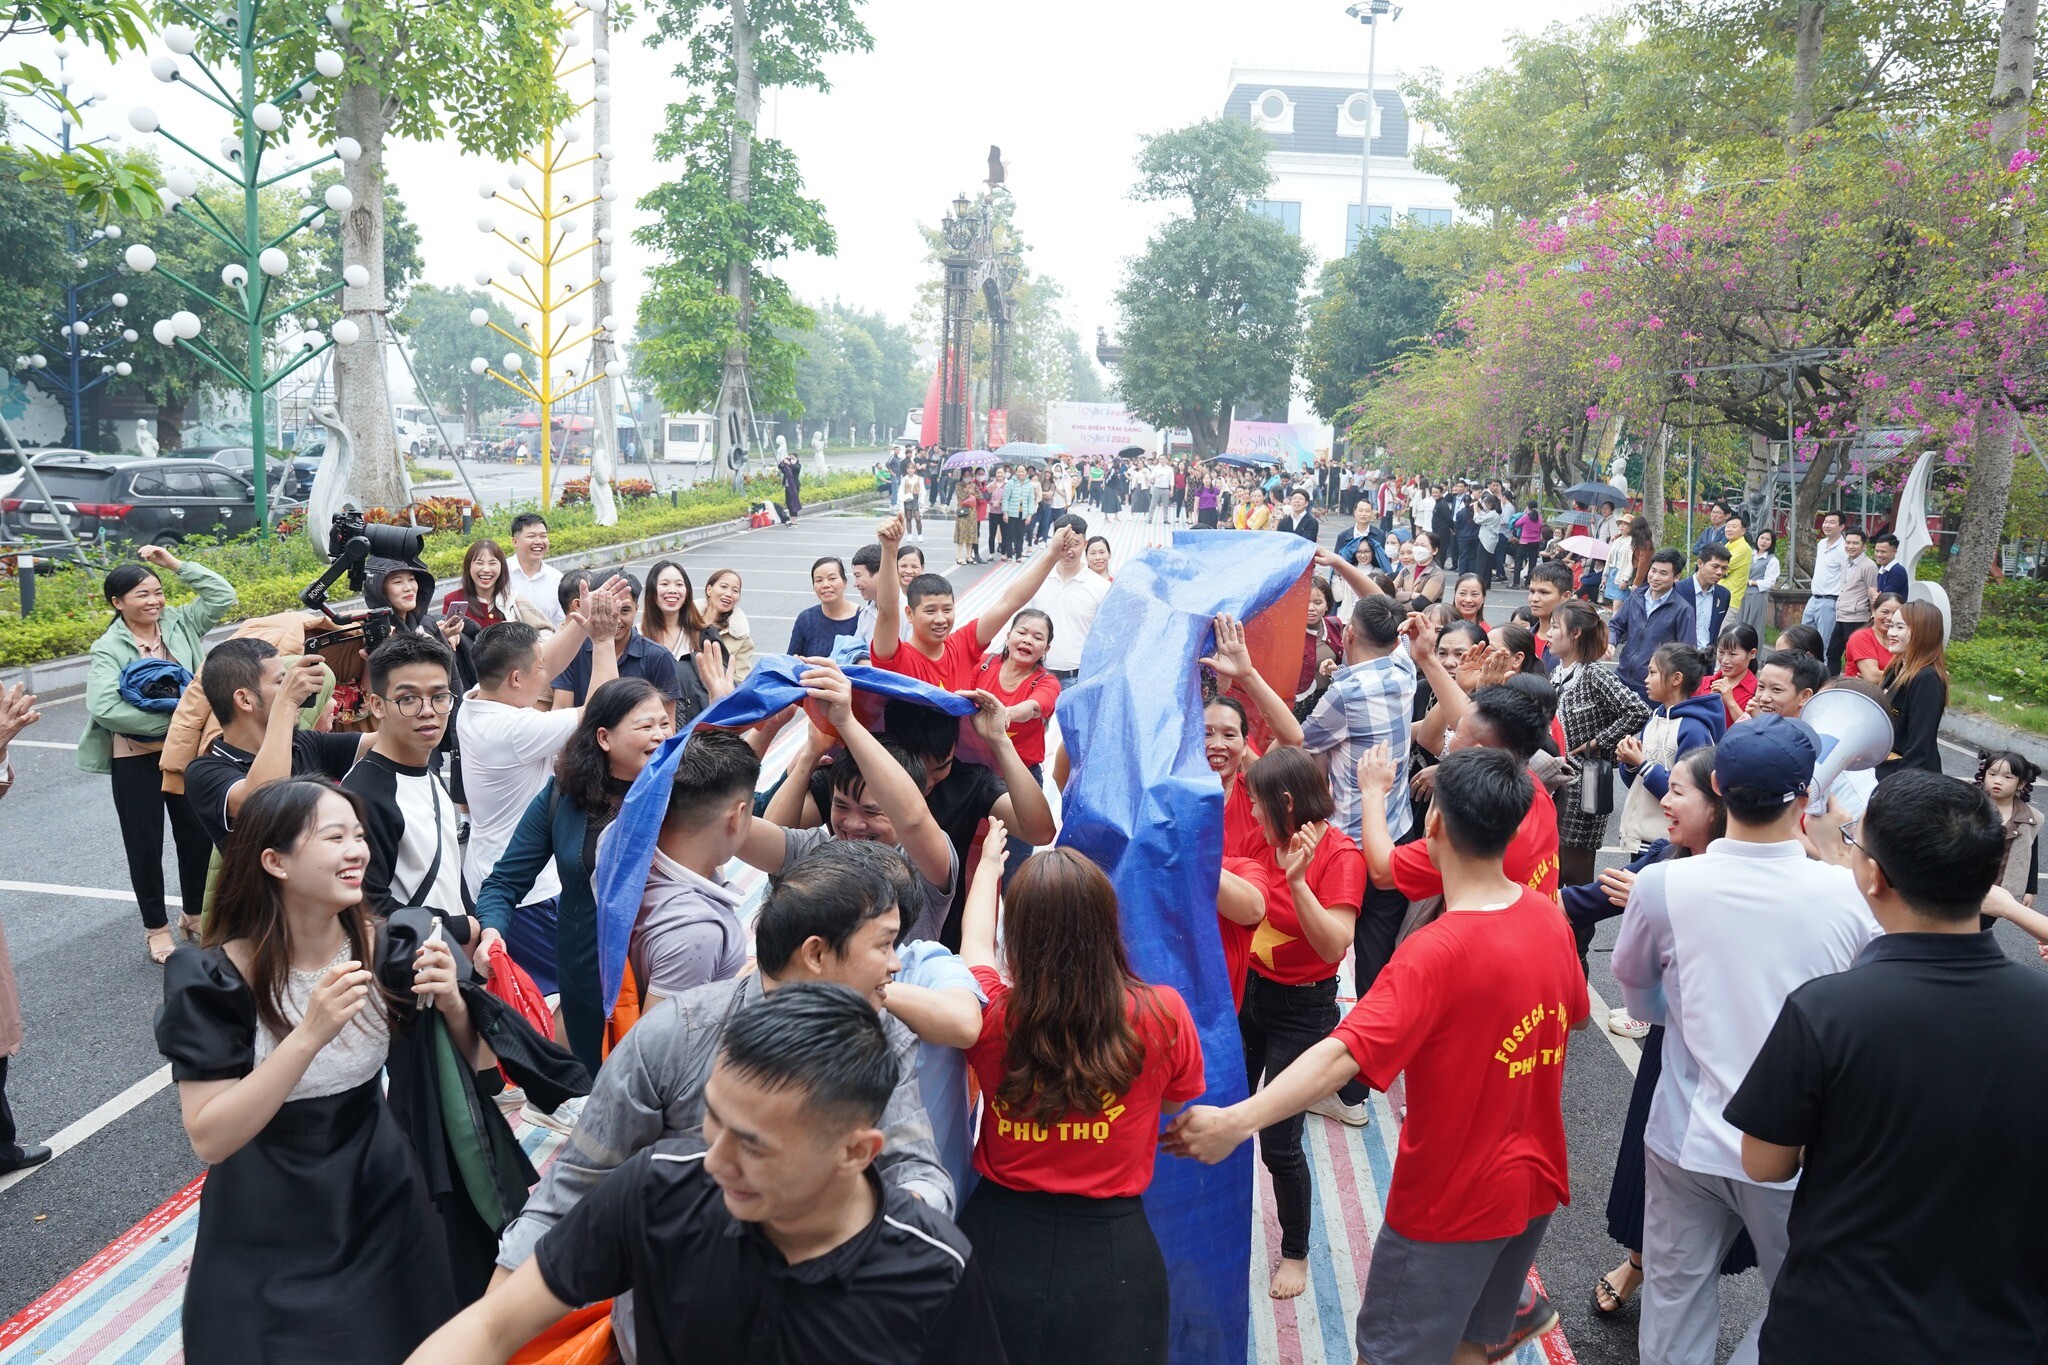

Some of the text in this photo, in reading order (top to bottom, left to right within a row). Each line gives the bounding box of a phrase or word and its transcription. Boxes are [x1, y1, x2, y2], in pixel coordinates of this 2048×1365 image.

[1111, 435, 1131, 443] 2023
[308, 581, 325, 600] RONIN
[1528, 858, 1549, 890] SECA
[1494, 1003, 1544, 1064] FOSECA
[1056, 1121, 1109, 1144] THỌ
